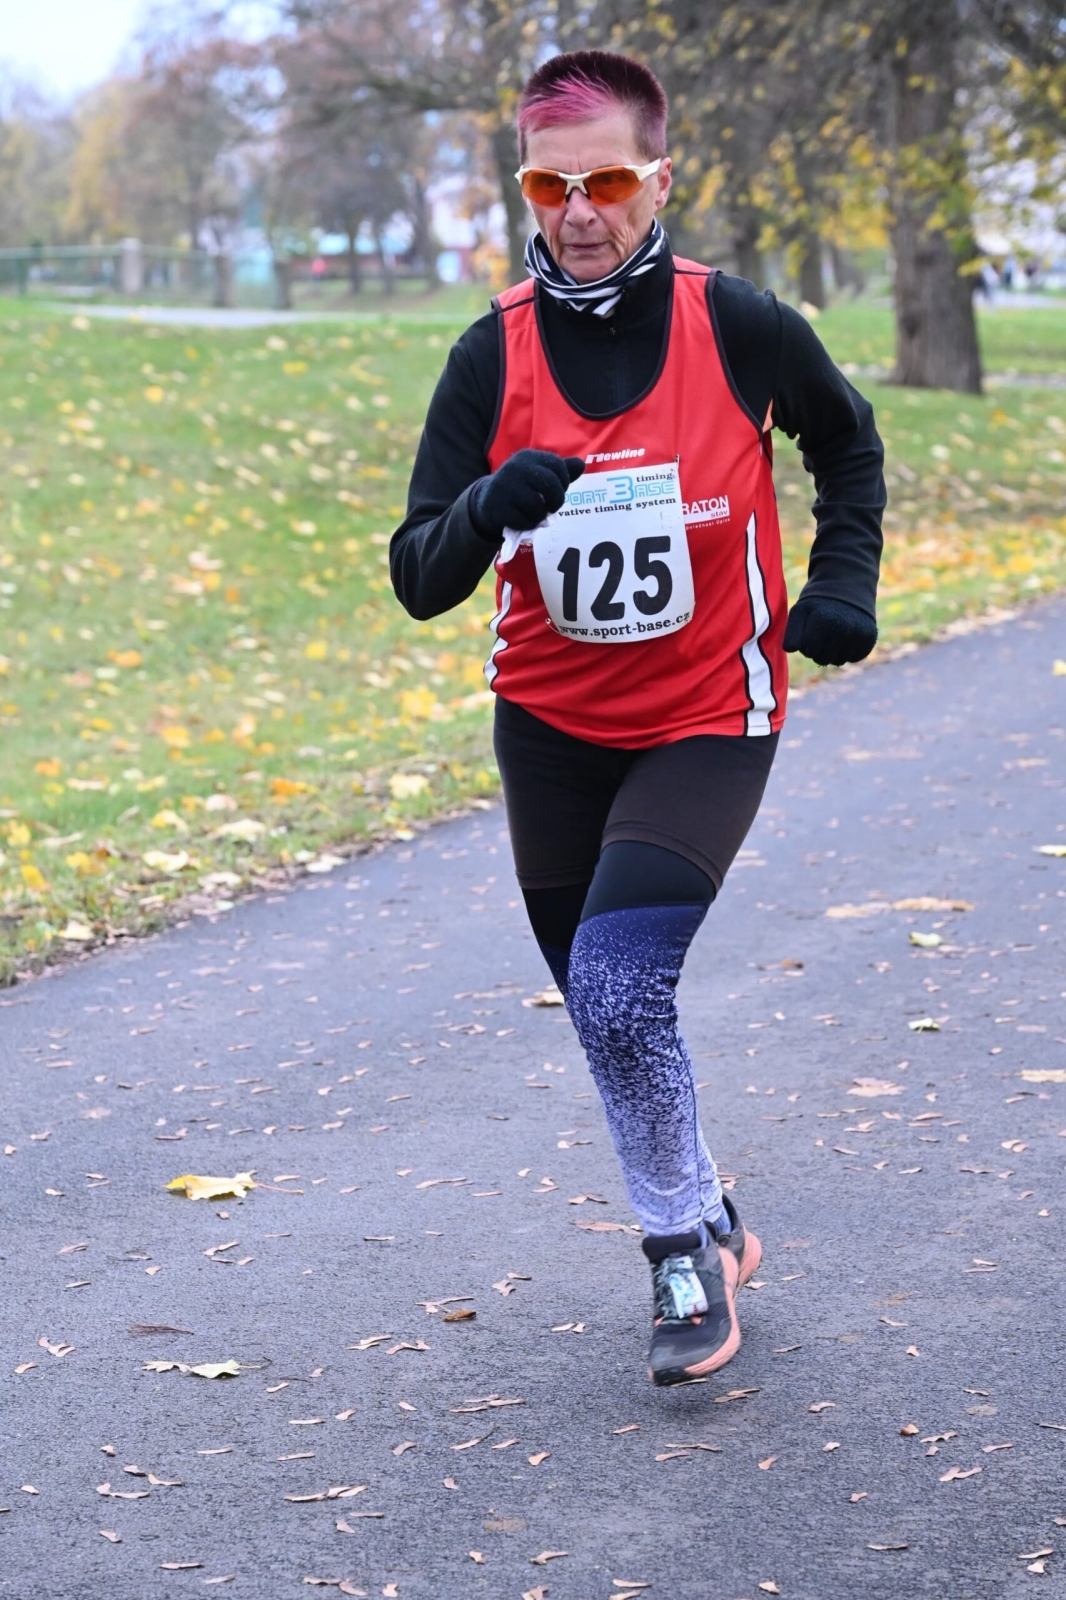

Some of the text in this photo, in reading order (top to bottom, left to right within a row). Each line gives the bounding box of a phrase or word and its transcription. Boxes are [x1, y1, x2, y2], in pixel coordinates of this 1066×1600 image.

[636, 472, 674, 483] timing
[594, 502, 633, 514] timing
[636, 498, 677, 509] system
[557, 535, 673, 622] 125
[559, 612, 690, 639] www.sport-base.cz
